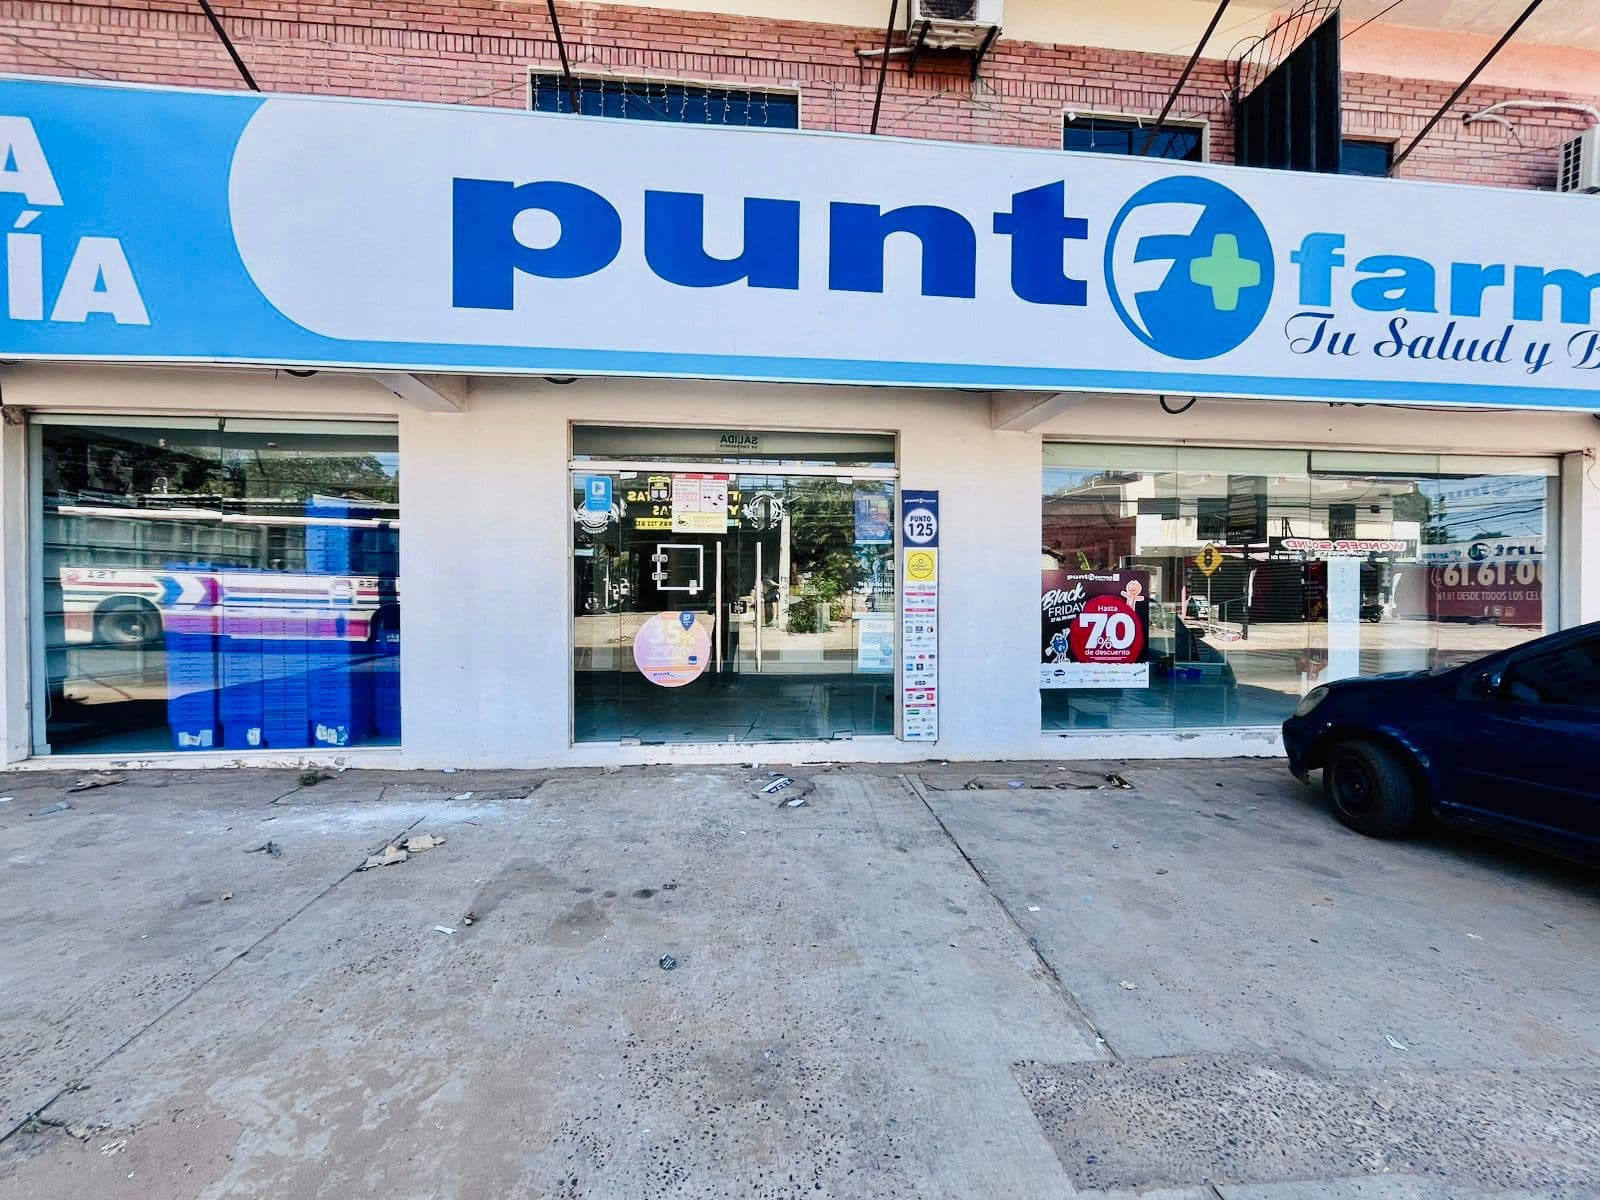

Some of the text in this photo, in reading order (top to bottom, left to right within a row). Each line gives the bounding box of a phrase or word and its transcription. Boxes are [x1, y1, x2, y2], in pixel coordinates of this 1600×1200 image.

[1285, 311, 1360, 356] Tu
[1373, 317, 1515, 363] Salud
[1523, 342, 1554, 374] y
[908, 523, 934, 537] 125
[1041, 582, 1086, 611] Black
[1457, 591, 1479, 601] DESDE
[1481, 591, 1506, 601] TODOS
[1508, 591, 1523, 601] LOS
[1048, 601, 1086, 617] FRIDAY
[1080, 613, 1136, 650] 70
